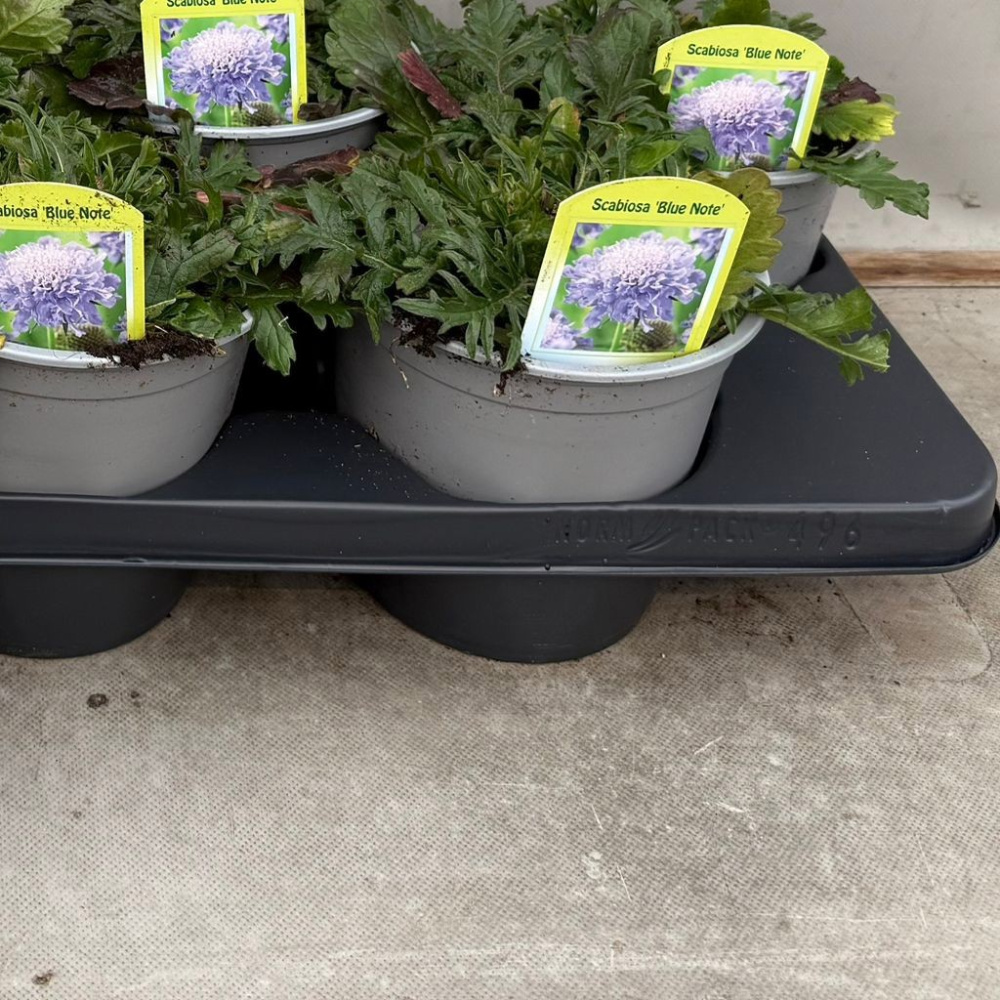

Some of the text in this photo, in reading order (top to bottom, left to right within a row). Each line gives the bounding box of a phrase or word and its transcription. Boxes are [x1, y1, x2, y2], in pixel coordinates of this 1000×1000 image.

[687, 43, 806, 61] Scabiosa 'Blue Note'
[591, 198, 725, 216] Scabiosa 'Blue Note'
